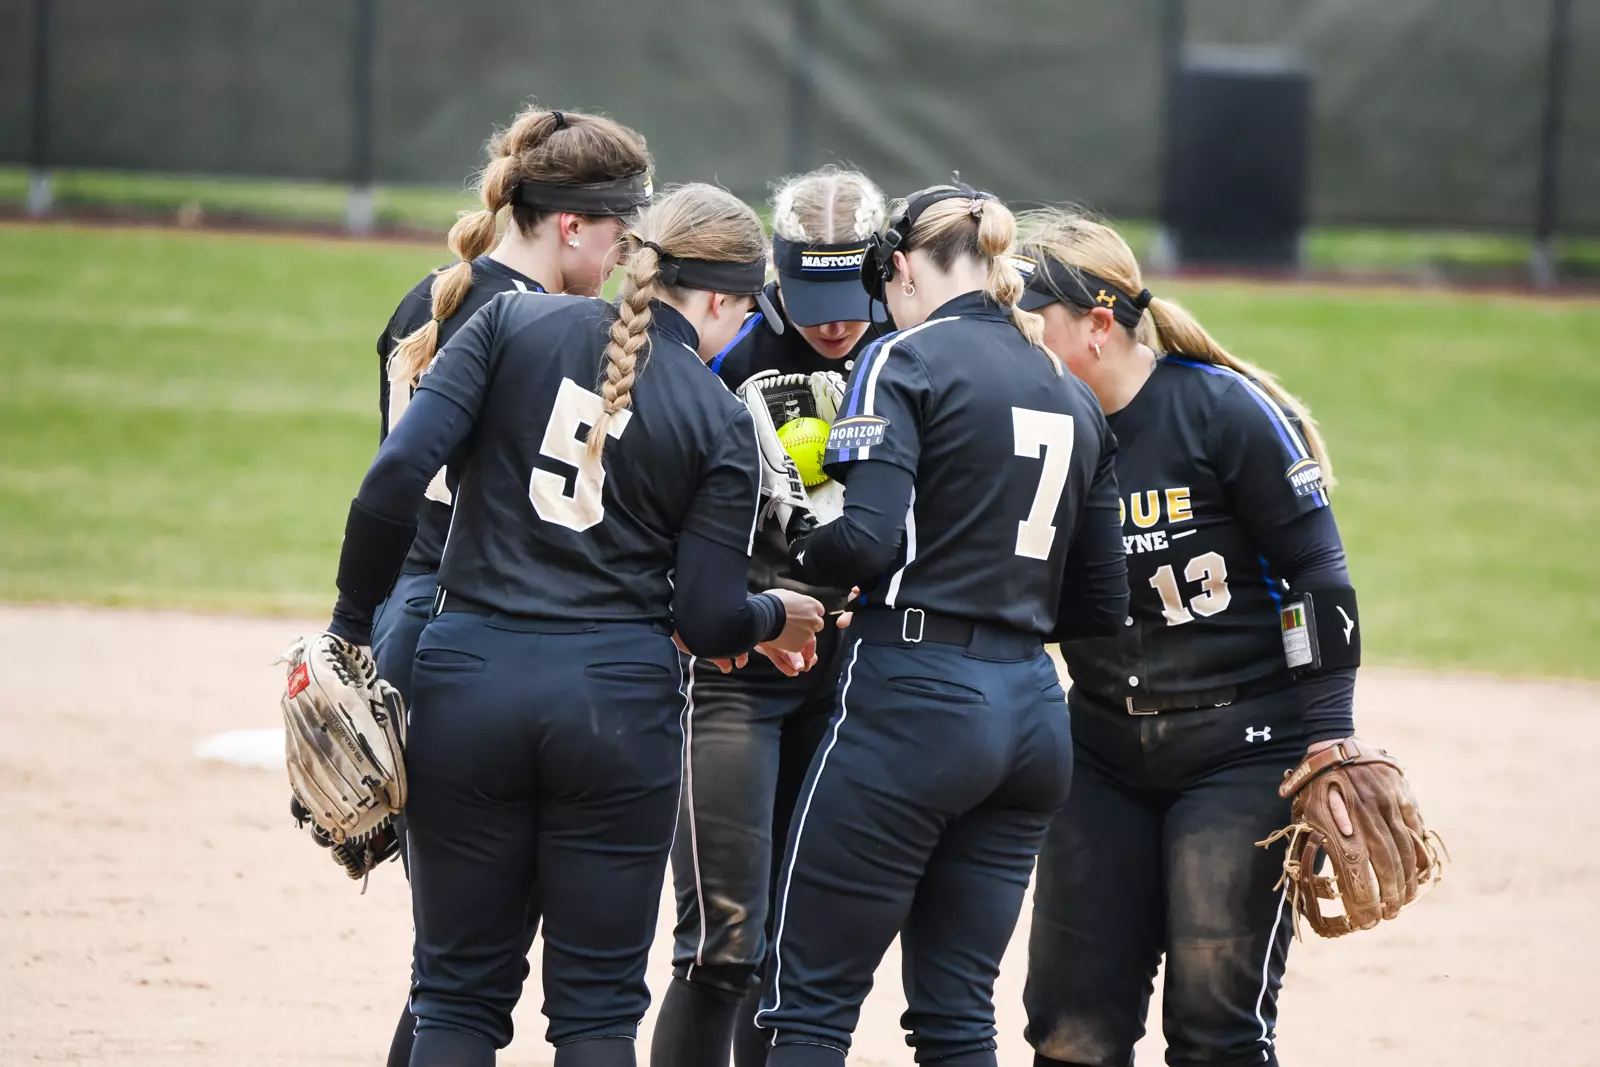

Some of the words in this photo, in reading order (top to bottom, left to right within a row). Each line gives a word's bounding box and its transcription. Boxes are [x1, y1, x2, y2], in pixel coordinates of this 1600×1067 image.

[528, 376, 633, 533] 5
[827, 437, 881, 448] LEAGUE
[829, 424, 884, 441] HORIZON
[1011, 406, 1074, 561] 7
[1149, 551, 1232, 626] 13
[354, 750, 364, 763] THE
